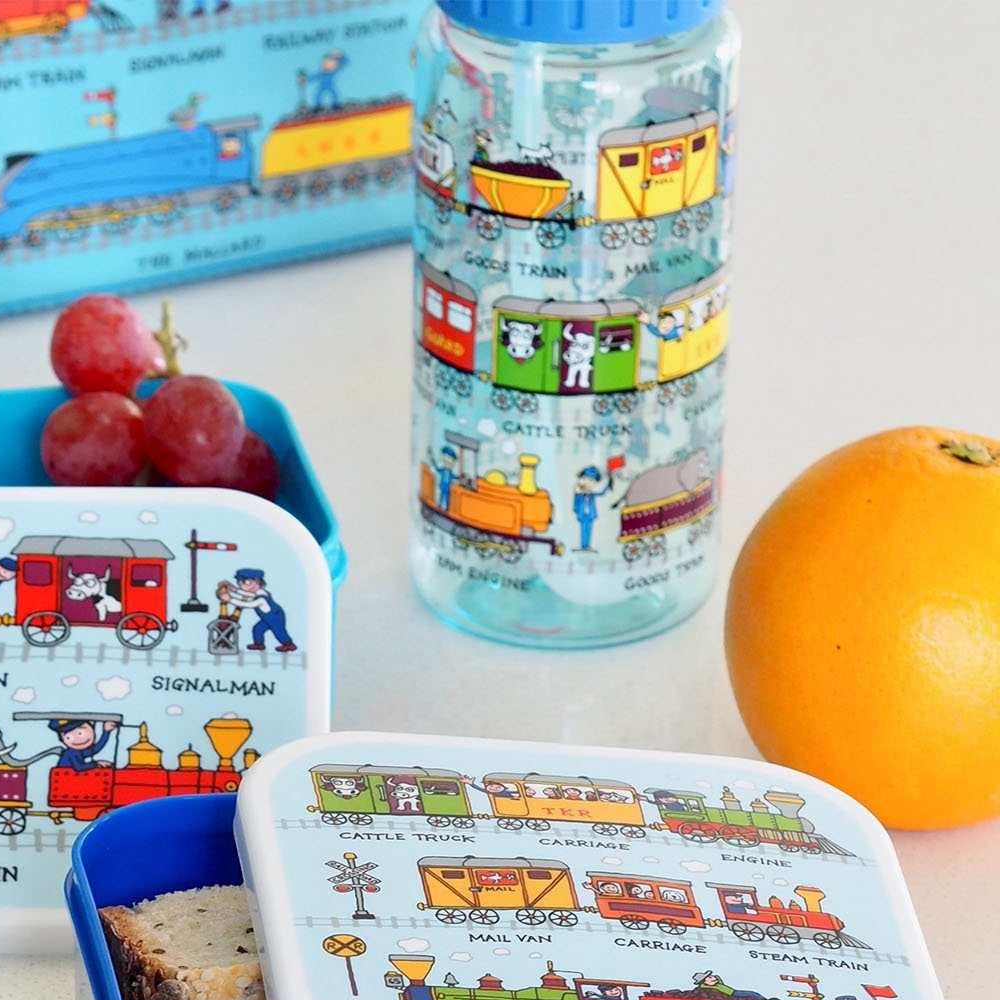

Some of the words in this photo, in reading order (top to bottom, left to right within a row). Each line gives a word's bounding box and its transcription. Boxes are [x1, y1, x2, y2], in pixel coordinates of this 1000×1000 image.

[517, 262, 568, 279] TRAIN
[503, 421, 564, 439] CATTLE
[574, 424, 633, 440] TRUCK
[468, 567, 531, 592] ENGINE
[151, 675, 276, 697] SIGNALMAN
[541, 806, 594, 819] TKR
[339, 831, 406, 842] CATTLE
[412, 832, 477, 844] TRUCK
[538, 837, 632, 852] CARRIAGE
[720, 853, 793, 869] ENGINE
[485, 885, 516, 893] MAIL
[326, 941, 336, 951] R
[353, 942, 364, 951] R
[469, 933, 511, 944] MAIL
[516, 934, 553, 944] VAN
[614, 937, 708, 955] CARRIAGE
[748, 949, 810, 965] STEAM
[812, 956, 870, 973] TRAIN
